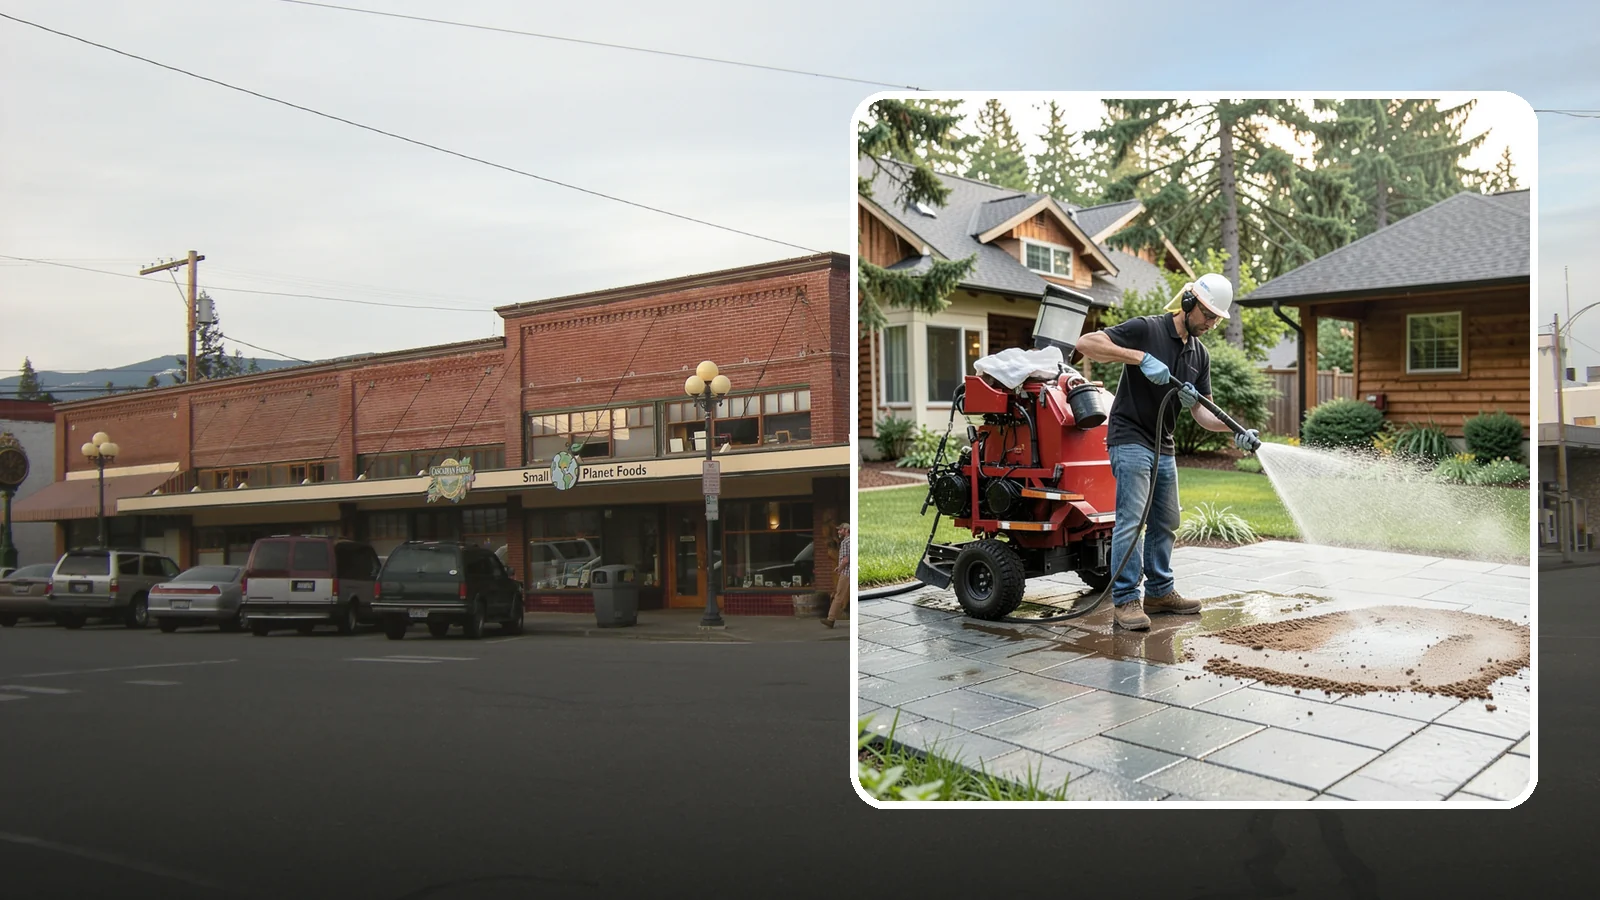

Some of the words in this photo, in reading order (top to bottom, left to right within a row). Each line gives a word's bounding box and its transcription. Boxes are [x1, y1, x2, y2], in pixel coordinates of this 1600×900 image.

[523, 471, 549, 483] Small
[583, 467, 614, 479] Planet
[617, 464, 647, 477] Foods
